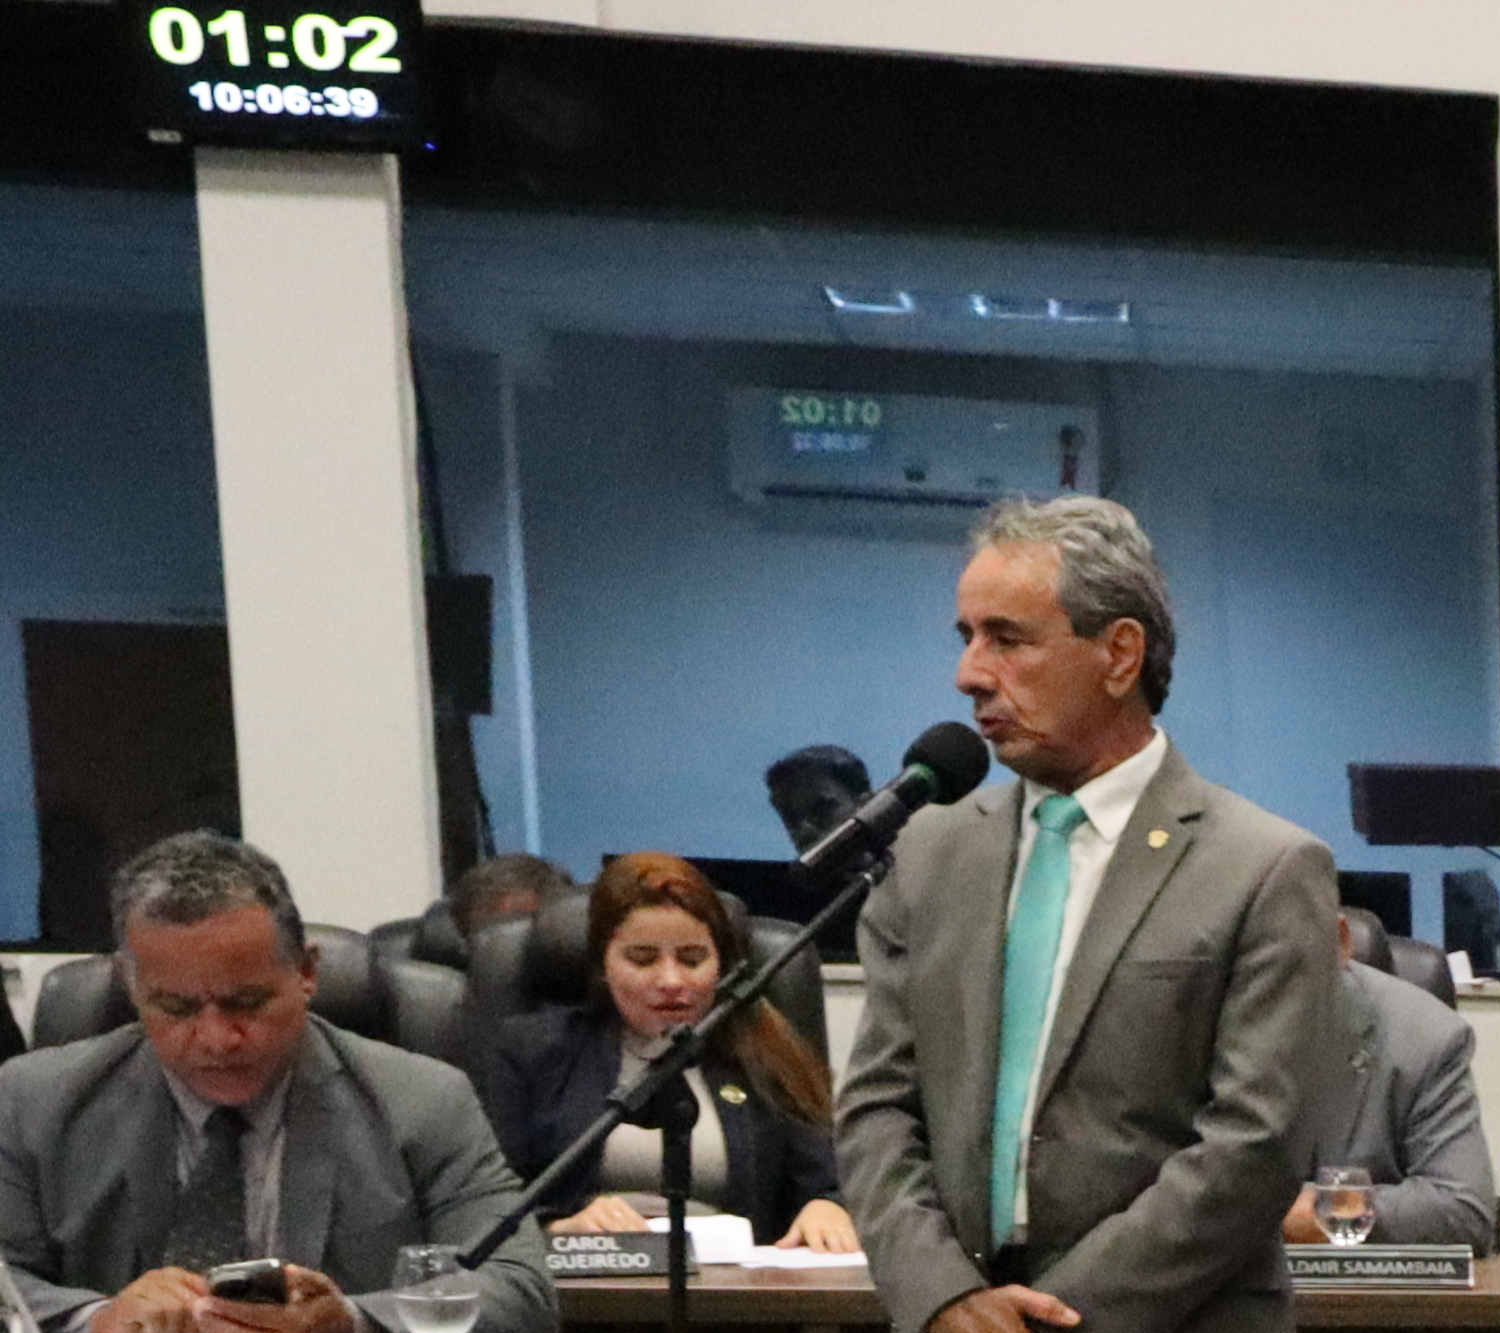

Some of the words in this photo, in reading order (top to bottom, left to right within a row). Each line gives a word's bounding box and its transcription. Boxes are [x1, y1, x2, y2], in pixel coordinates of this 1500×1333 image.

[149, 7, 402, 73] 01:02
[188, 80, 379, 118] 10:06:39
[552, 1235, 622, 1251] CAROL
[546, 1252, 650, 1270] GUEIREDO
[1343, 1259, 1456, 1275] SAMAMBAIA
